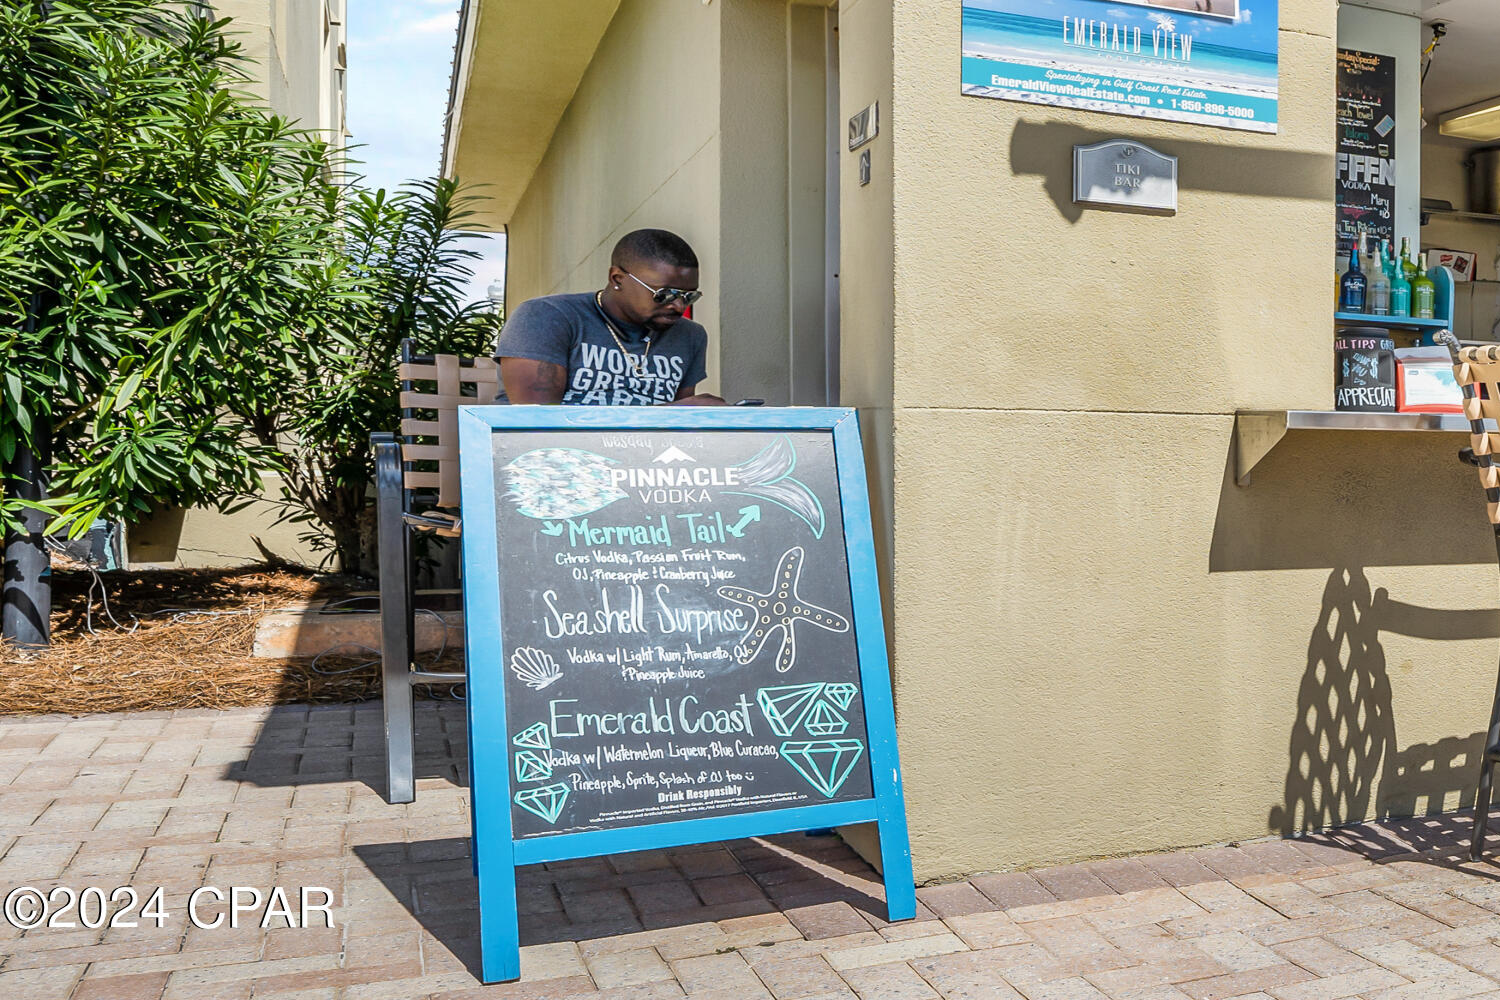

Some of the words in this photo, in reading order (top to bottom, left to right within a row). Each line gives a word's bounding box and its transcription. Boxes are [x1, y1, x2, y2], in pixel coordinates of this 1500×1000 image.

[1063, 15, 1141, 54] EMERALD
[1152, 27, 1193, 61] VIEW
[991, 74, 1151, 105] EmeraldViewRealEstate.com
[1045, 70, 1100, 87] Specializing
[1102, 78, 1112, 86] in
[1113, 79, 1133, 92] Gulf
[1135, 82, 1160, 93] Coast
[1161, 85, 1181, 96] Real
[1115, 163, 1140, 175] TIKI
[1114, 176, 1141, 188] BAR
[1341, 180, 1371, 191] VODKA
[1371, 193, 1389, 211] Mary
[1335, 339, 1349, 350] ALL
[1351, 339, 1376, 349] TIPS
[581, 342, 684, 381] WORLDS
[572, 367, 680, 402] GREATEST
[610, 467, 741, 488] PINNACLE
[638, 489, 712, 504] VODKA
[566, 515, 672, 547] Mermaid
[676, 511, 726, 544] Tail
[555, 553, 590, 565] Citrus
[592, 550, 633, 565] Vodka,
[632, 551, 678, 563] Passion
[680, 548, 712, 563] Fruit
[712, 550, 746, 562] Rum,
[593, 569, 650, 584] Pineapple
[659, 568, 710, 587] Cranberry
[710, 566, 736, 580] Juice
[655, 583, 748, 645] Surprise
[566, 648, 604, 664] Vodka
[606, 647, 621, 666] w/
[623, 646, 654, 666] Light
[655, 646, 686, 664] Rum,
[684, 642, 733, 662] Amaretto,
[627, 666, 677, 684] Pineapple
[678, 664, 706, 679] Juice
[550, 696, 676, 737] Emerald
[679, 692, 755, 737] Coast
[544, 749, 581, 768] Vodka
[584, 746, 601, 770] w/
[603, 742, 665, 764] Watermelon
[668, 741, 710, 761] Liqueur,
[709, 741, 734, 758] Blue
[735, 739, 779, 760] Curacao,
[569, 772, 626, 795] Pineapple,
[626, 771, 659, 788] Sprite,
[659, 772, 694, 790] Splash
[697, 771, 709, 786] of
[710, 772, 722, 784] OJ
[726, 770, 743, 781] too
[658, 790, 685, 803] Drink
[686, 785, 742, 800] Responsibly
